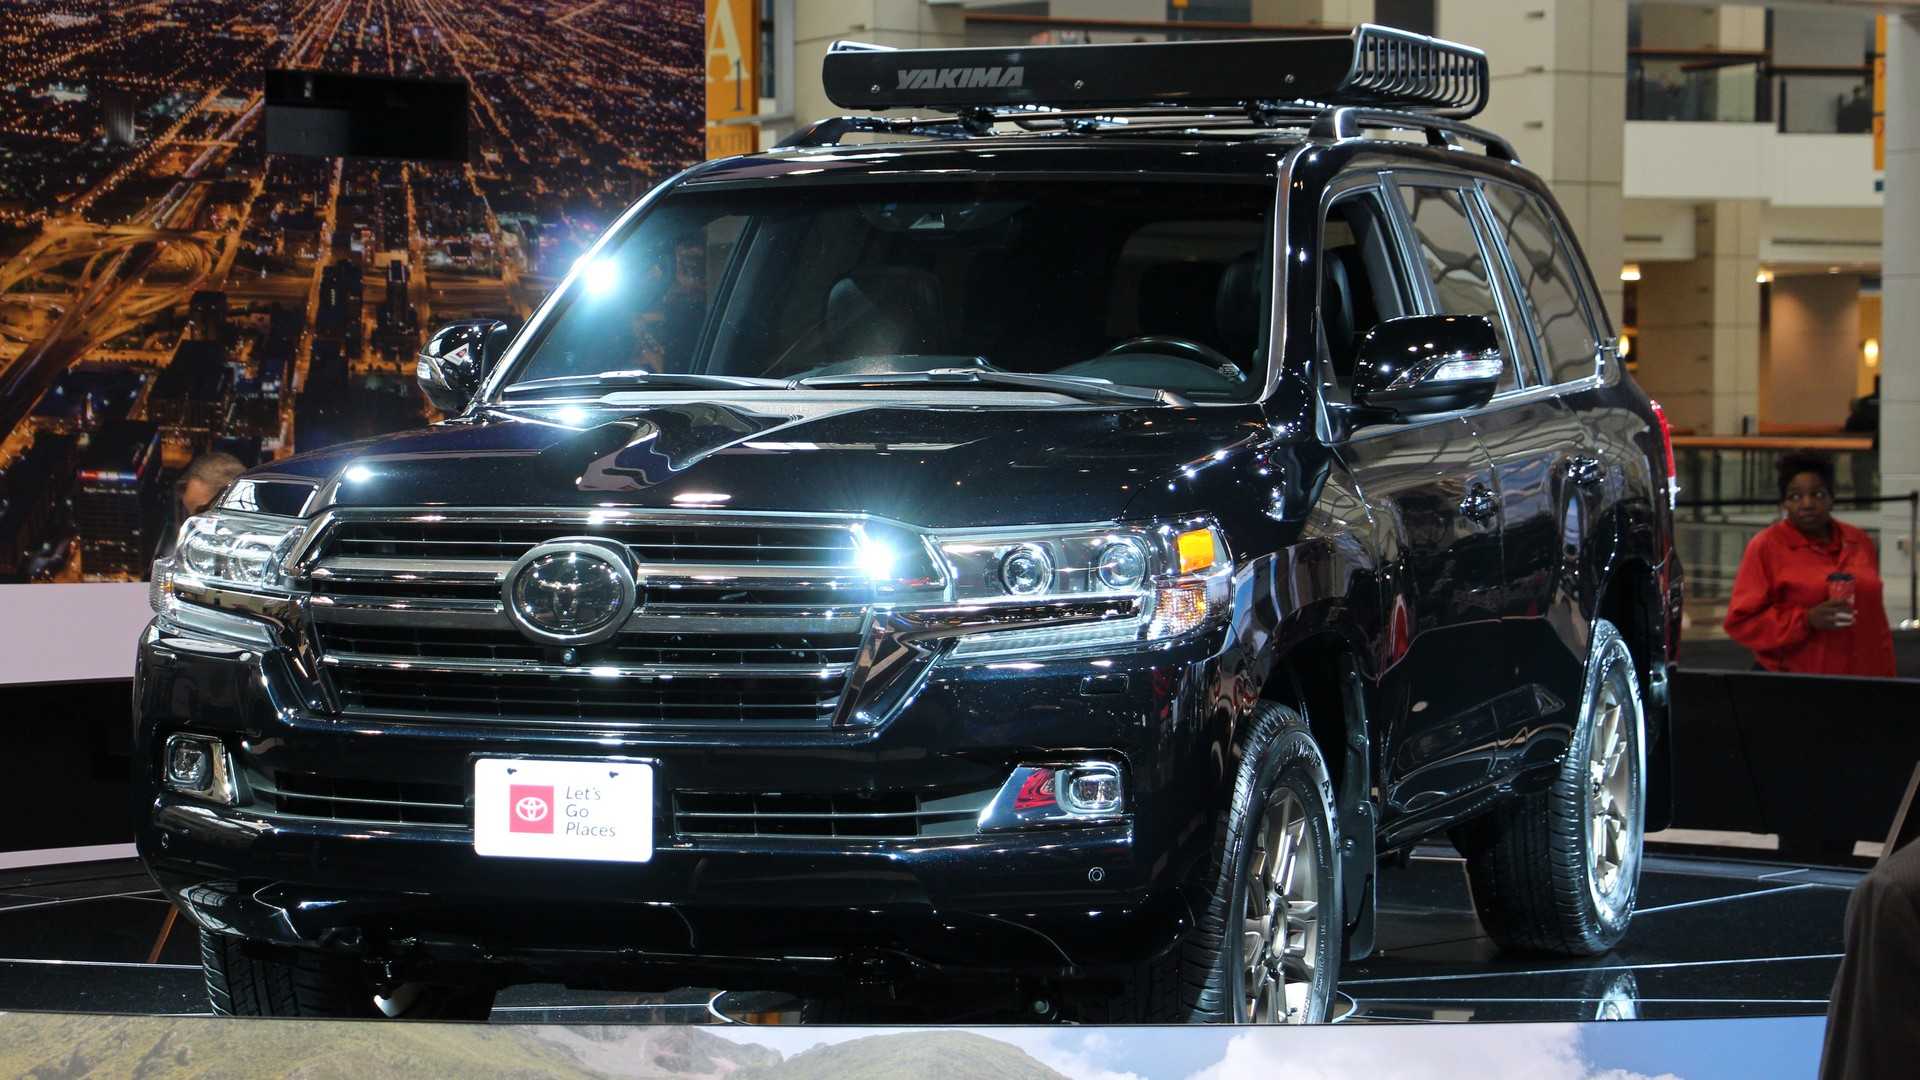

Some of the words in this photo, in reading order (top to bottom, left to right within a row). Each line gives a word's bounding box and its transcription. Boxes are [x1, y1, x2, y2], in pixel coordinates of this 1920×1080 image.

[705, 0, 749, 82] A
[730, 58, 746, 112] 1
[896, 66, 1025, 90] YAKIMA
[566, 785, 601, 801] Let's
[566, 803, 590, 818] Go
[565, 821, 617, 838] Places
